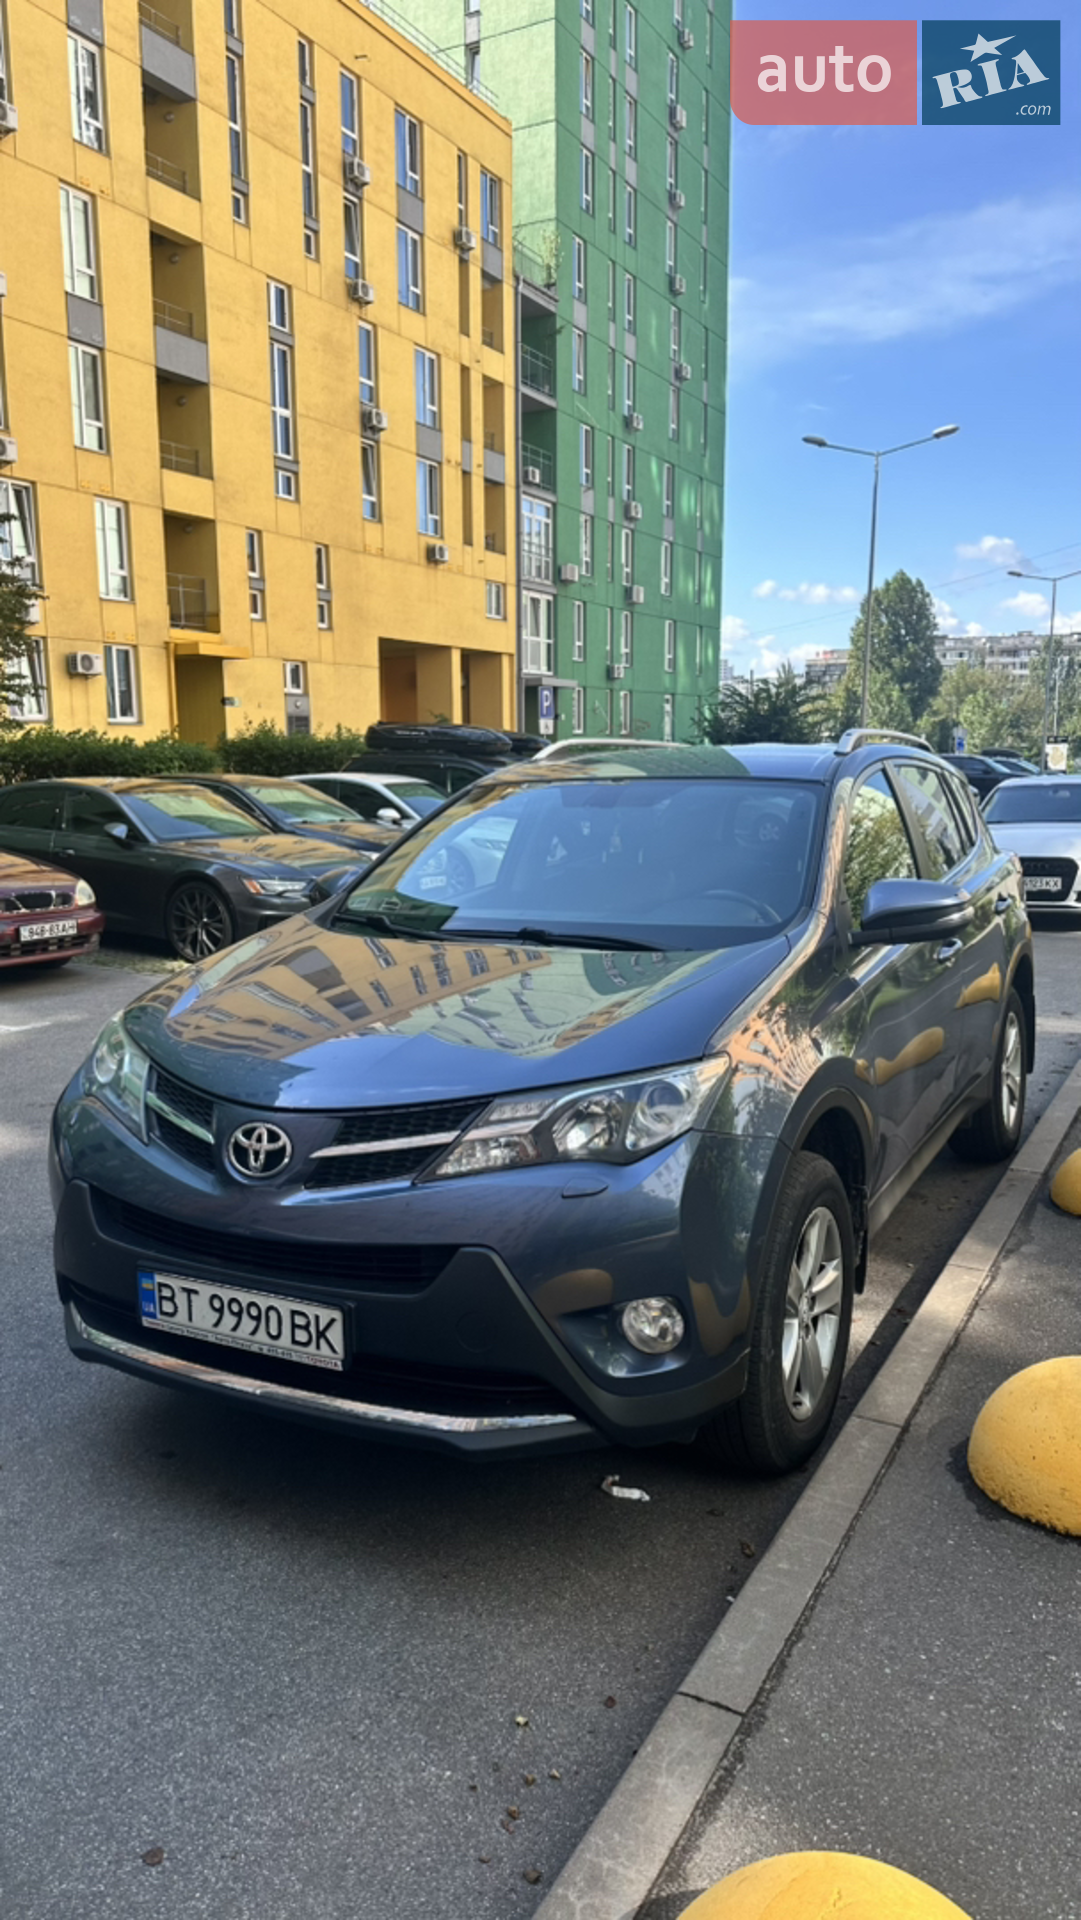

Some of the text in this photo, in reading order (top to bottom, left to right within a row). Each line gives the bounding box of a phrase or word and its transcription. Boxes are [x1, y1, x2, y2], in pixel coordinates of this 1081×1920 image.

[542, 690, 551, 716] P
[157, 1281, 199, 1323] BT
[209, 1293, 283, 1341] 9990
[290, 1308, 339, 1355] BK
